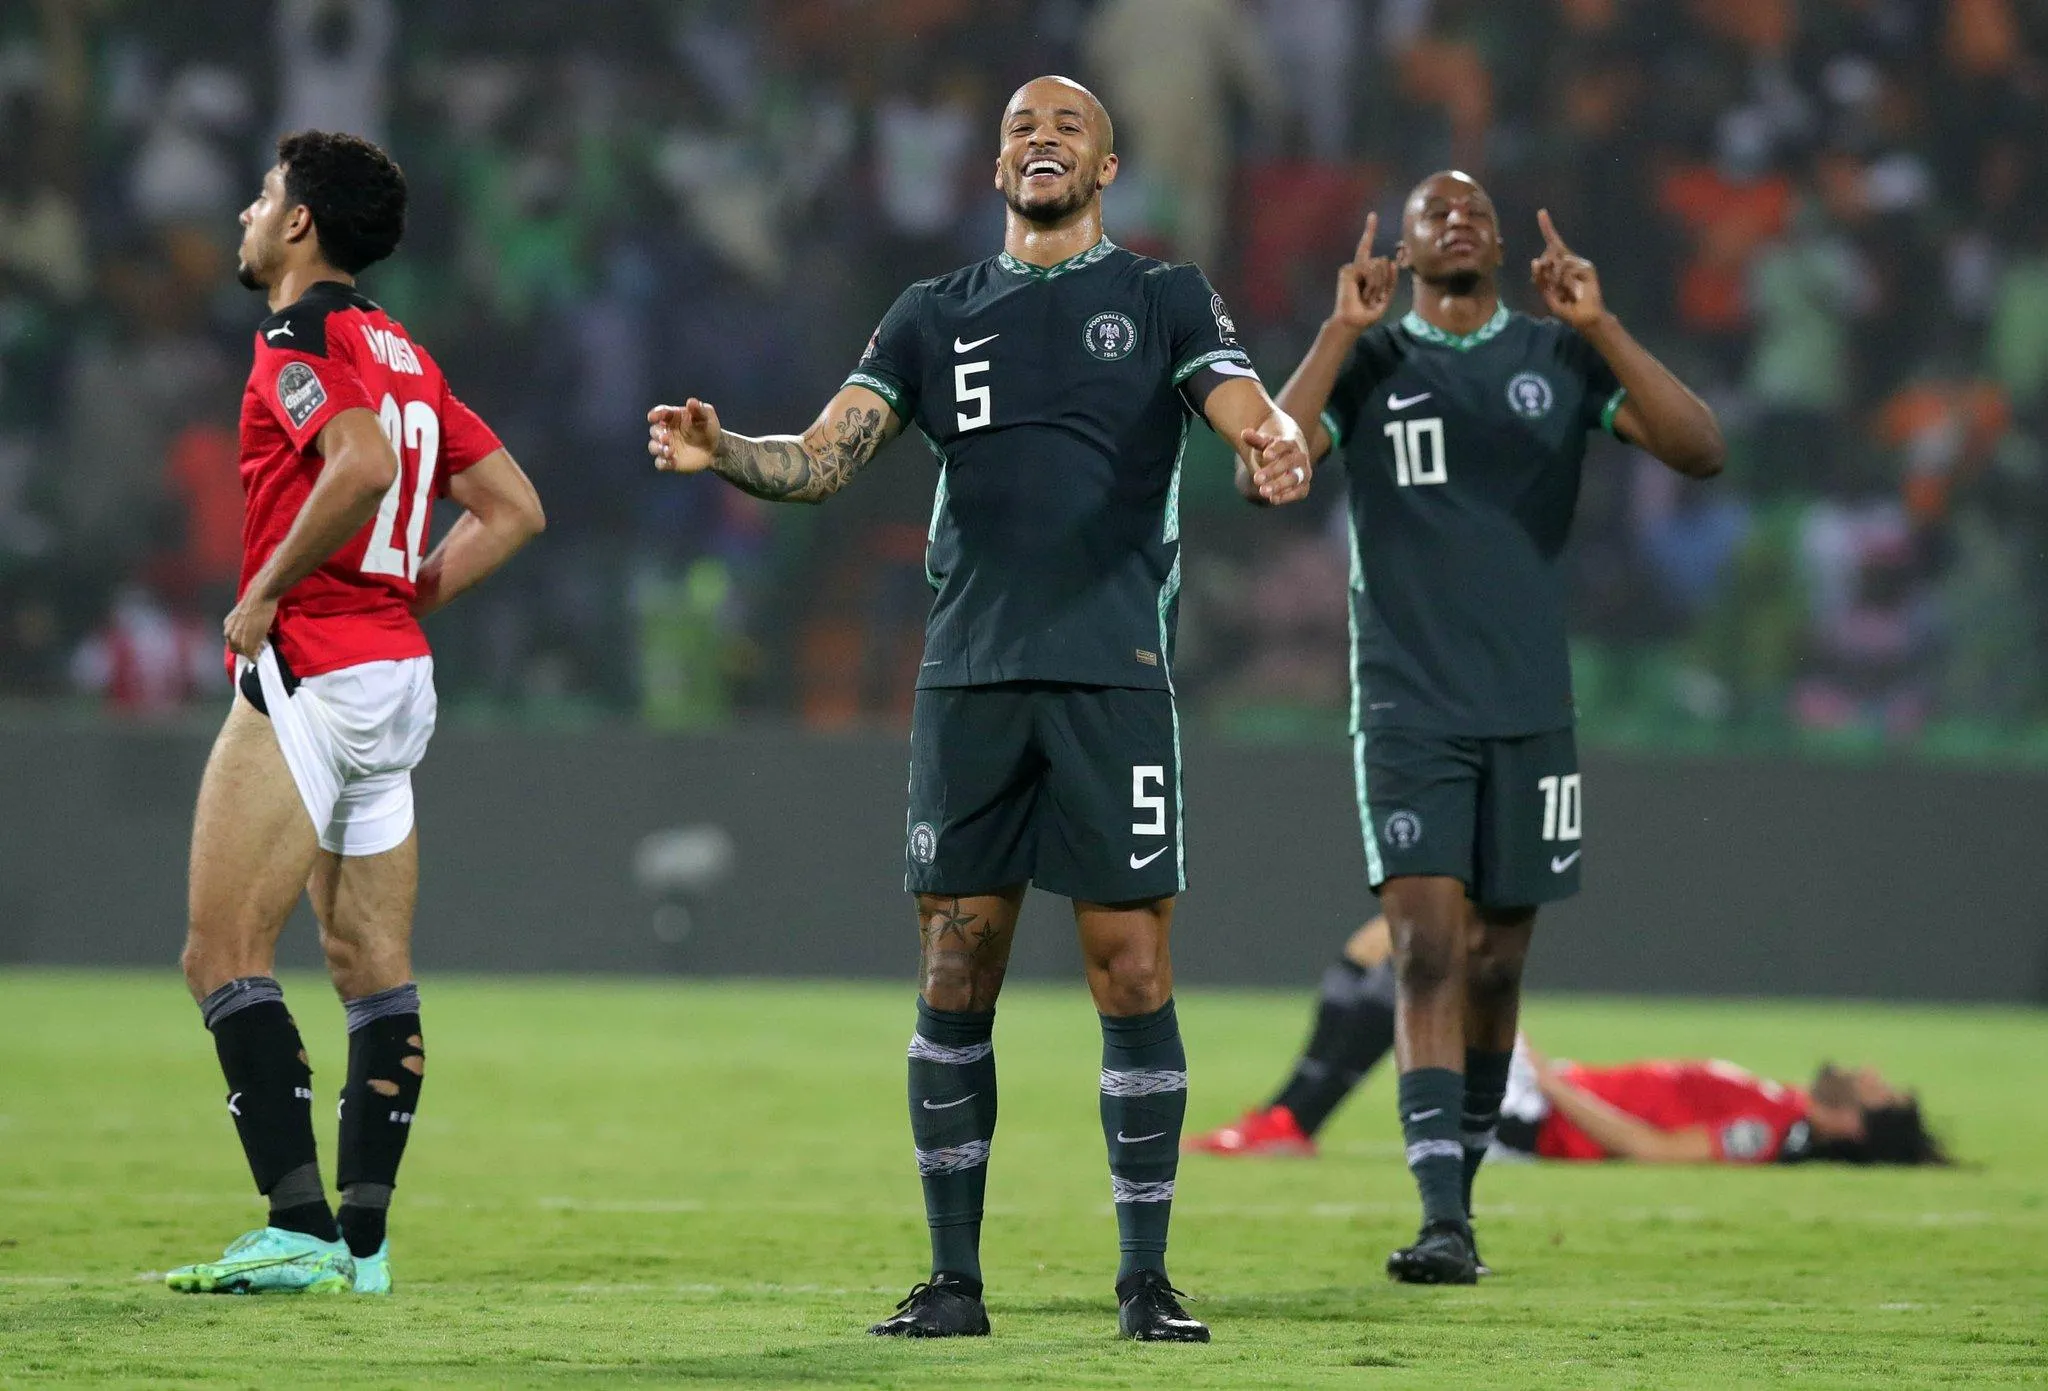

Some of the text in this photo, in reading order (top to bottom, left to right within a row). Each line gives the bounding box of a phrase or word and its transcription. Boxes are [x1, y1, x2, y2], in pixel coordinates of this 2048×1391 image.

[1089, 314, 1119, 329] FOOTBALL
[1119, 316, 1135, 352] FEDERATION
[954, 360, 991, 432] 5
[1384, 416, 1448, 486] 10
[360, 392, 440, 583] 22
[1132, 765, 1166, 835] 5
[1538, 773, 1582, 841] 10
